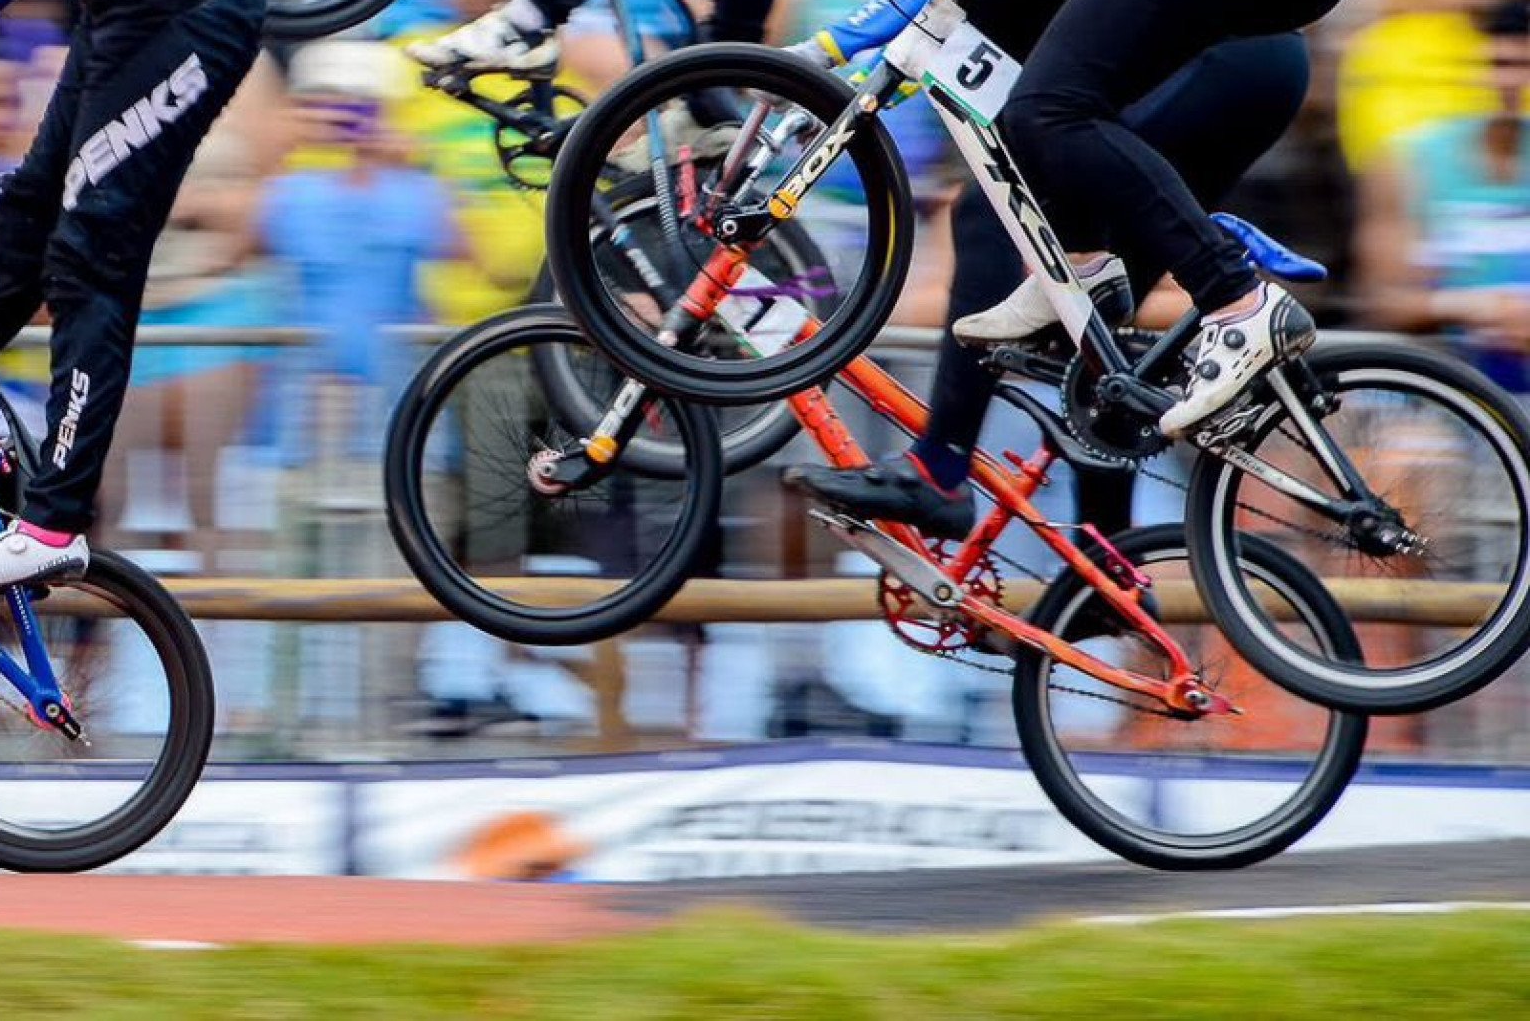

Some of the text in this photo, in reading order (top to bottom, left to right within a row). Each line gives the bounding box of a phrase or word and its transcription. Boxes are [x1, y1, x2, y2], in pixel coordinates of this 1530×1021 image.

[956, 41, 1004, 91] 5
[62, 52, 209, 211] PENKS
[52, 368, 90, 471] PENKS
